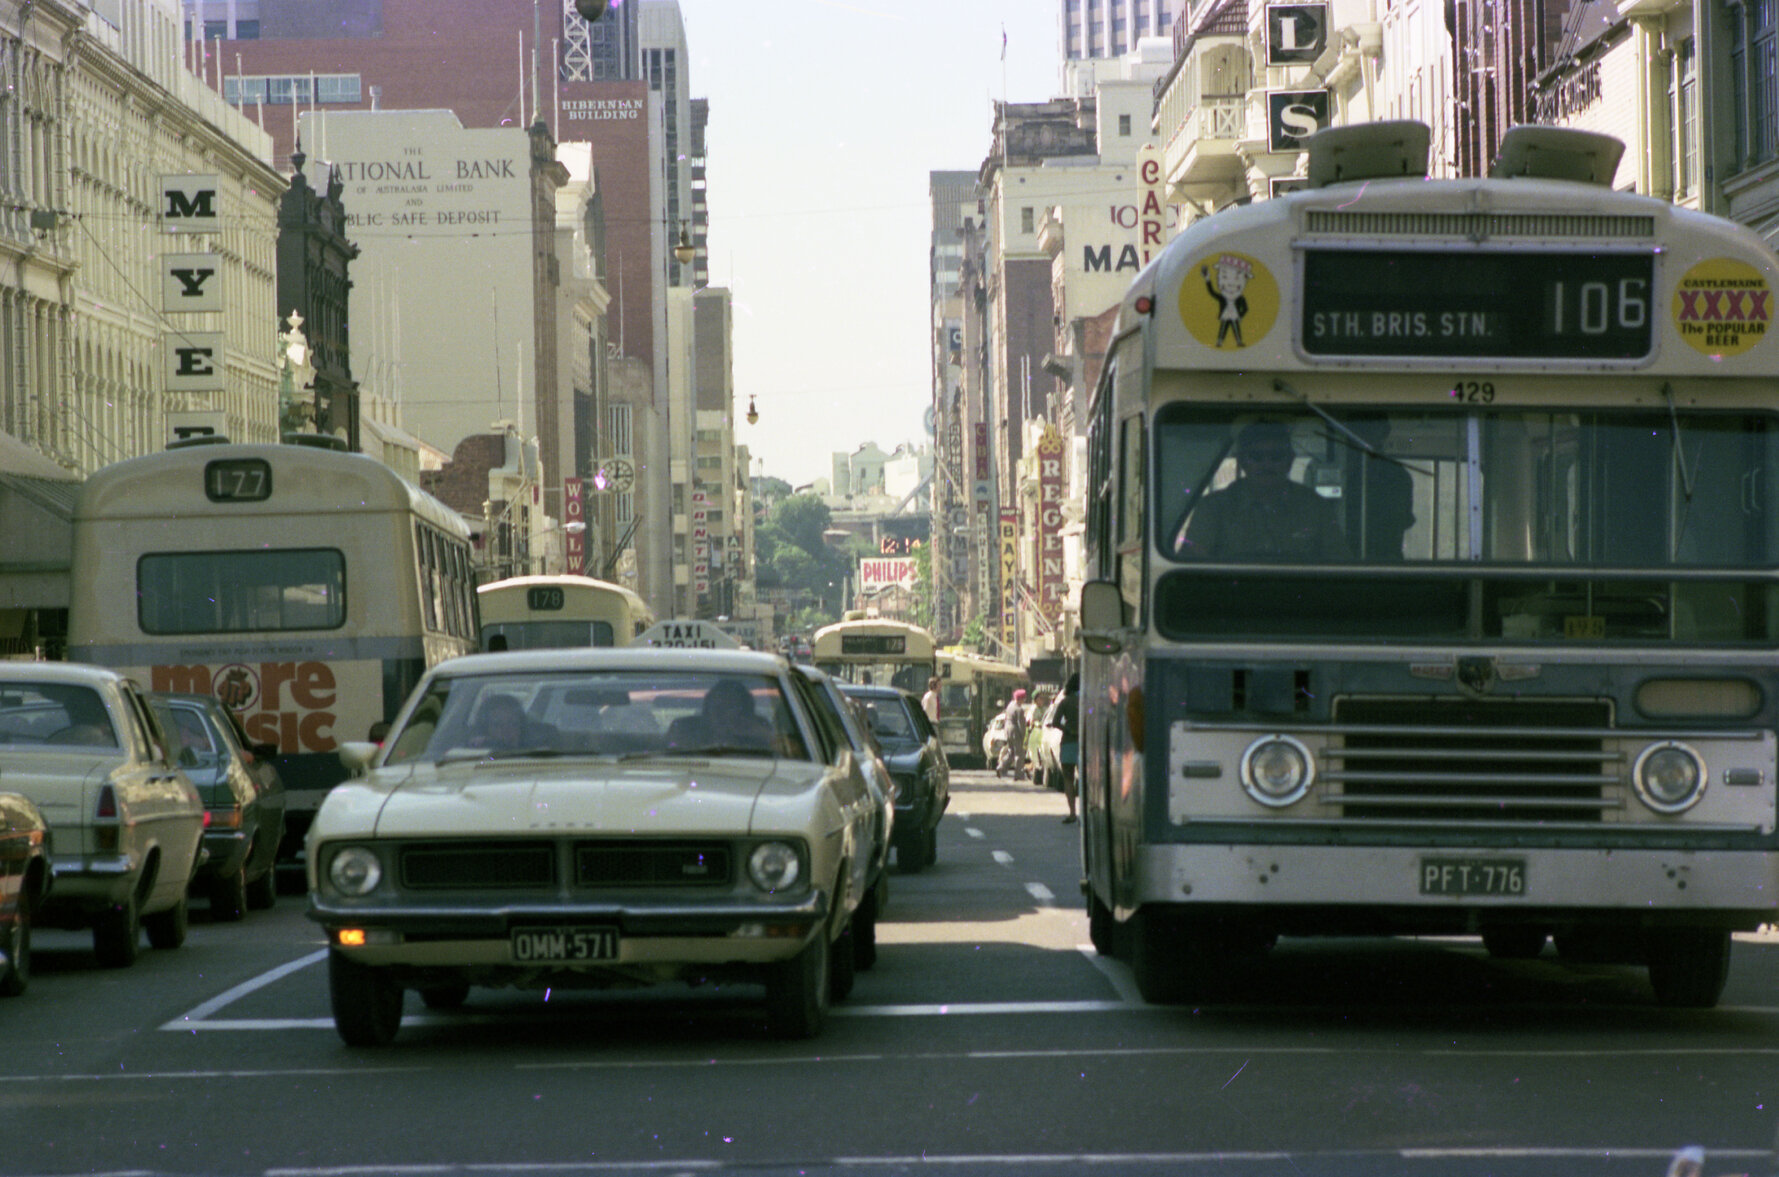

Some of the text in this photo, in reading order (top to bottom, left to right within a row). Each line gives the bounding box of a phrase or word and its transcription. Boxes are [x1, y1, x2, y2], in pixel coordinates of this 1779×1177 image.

[562, 100, 643, 110] HIBERNIAN
[569, 110, 638, 120] BUILDING
[403, 147, 423, 155] THE
[334, 159, 515, 181] ATIONAL BANK
[357, 184, 473, 194] OF AUSTRALASIA LIMITED
[347, 210, 501, 226] BLIC SAFE DEPOSIT
[1684, 279, 1763, 288] CASTLEMAINE
[1555, 279, 1646, 334] 106
[1679, 290, 1769, 320] XXXX
[1313, 312, 1492, 337] STH. BRIS. STN.
[1682, 323, 1765, 334] The POPULAR
[1706, 335, 1739, 346] BEER
[217, 469, 265, 497] 177
[567, 483, 583, 570] WOLW
[1042, 460, 1062, 600] REGENT
[863, 562, 917, 582] PHILIPS
[663, 624, 701, 639] TAXI
[246, 711, 337, 753] sic
